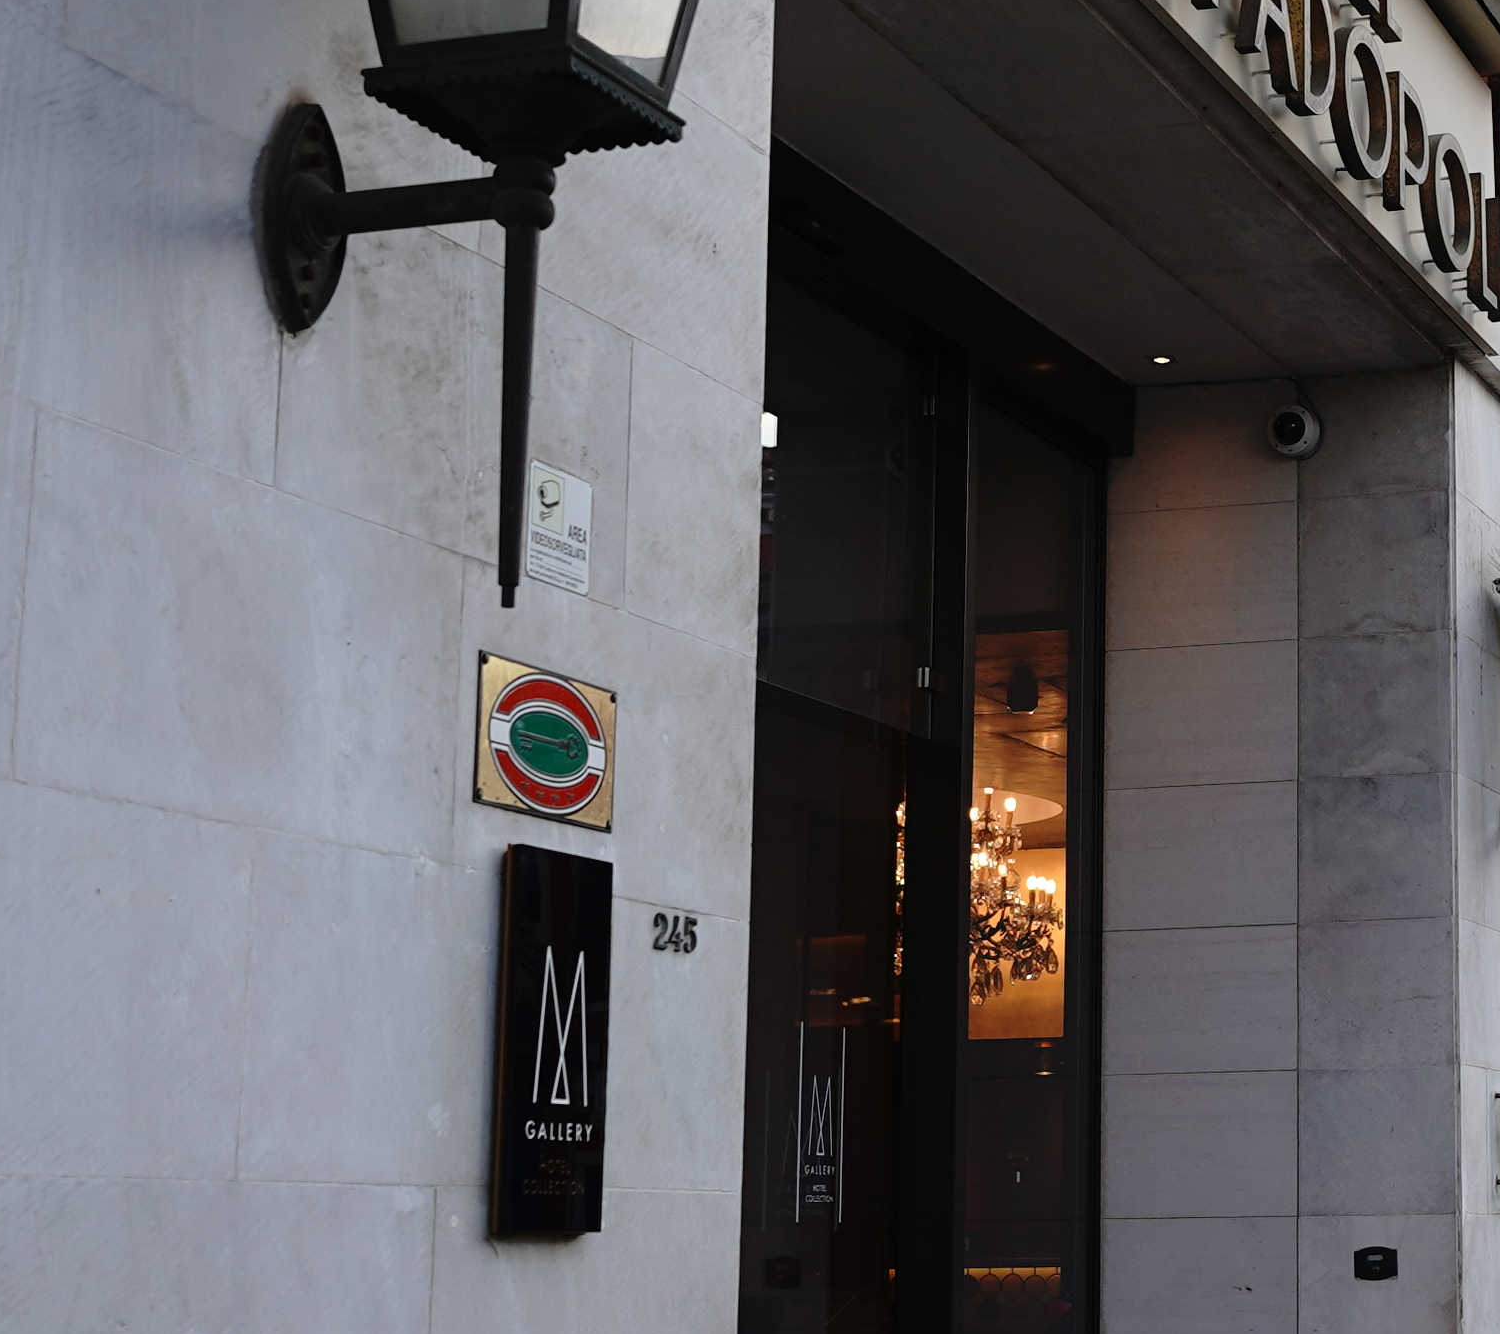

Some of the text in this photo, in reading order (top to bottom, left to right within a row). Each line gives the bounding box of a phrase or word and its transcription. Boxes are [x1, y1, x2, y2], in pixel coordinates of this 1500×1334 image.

[567, 524, 587, 546] AREA
[653, 912, 697, 953] 245
[524, 1119, 594, 1143] GALLERY
[804, 1164, 837, 1176] GALLERY
